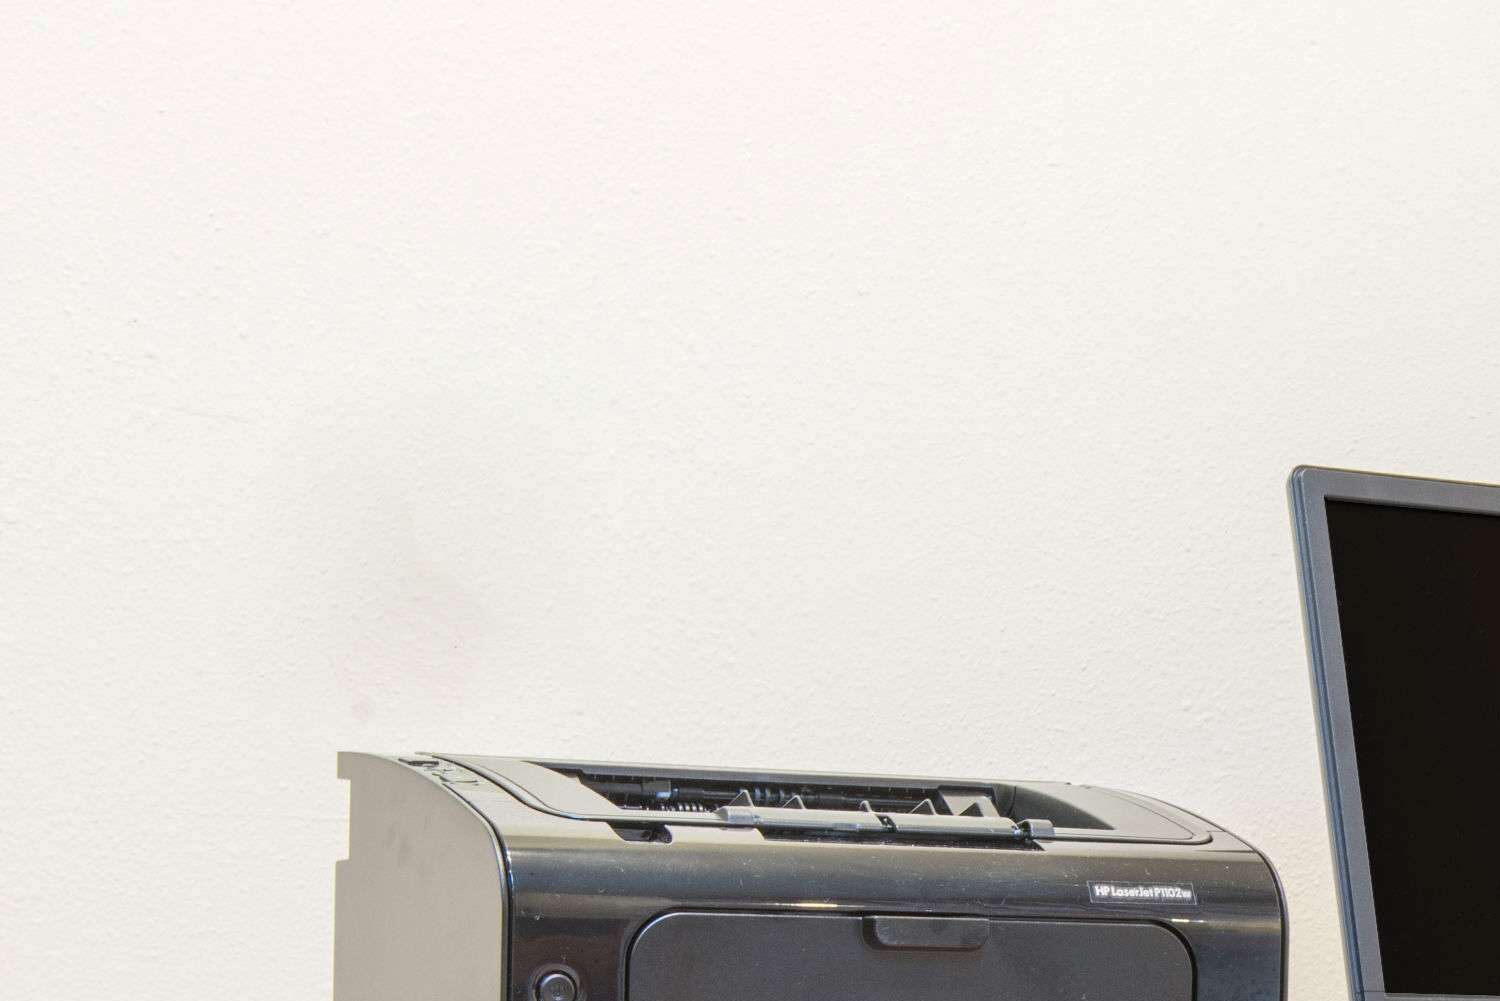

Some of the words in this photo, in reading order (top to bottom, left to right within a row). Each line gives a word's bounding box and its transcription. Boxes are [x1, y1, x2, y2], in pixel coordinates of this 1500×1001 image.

[1094, 885, 1110, 896] HP
[1111, 886, 1153, 897] LaserJet
[1154, 887, 1192, 898] P1102w
